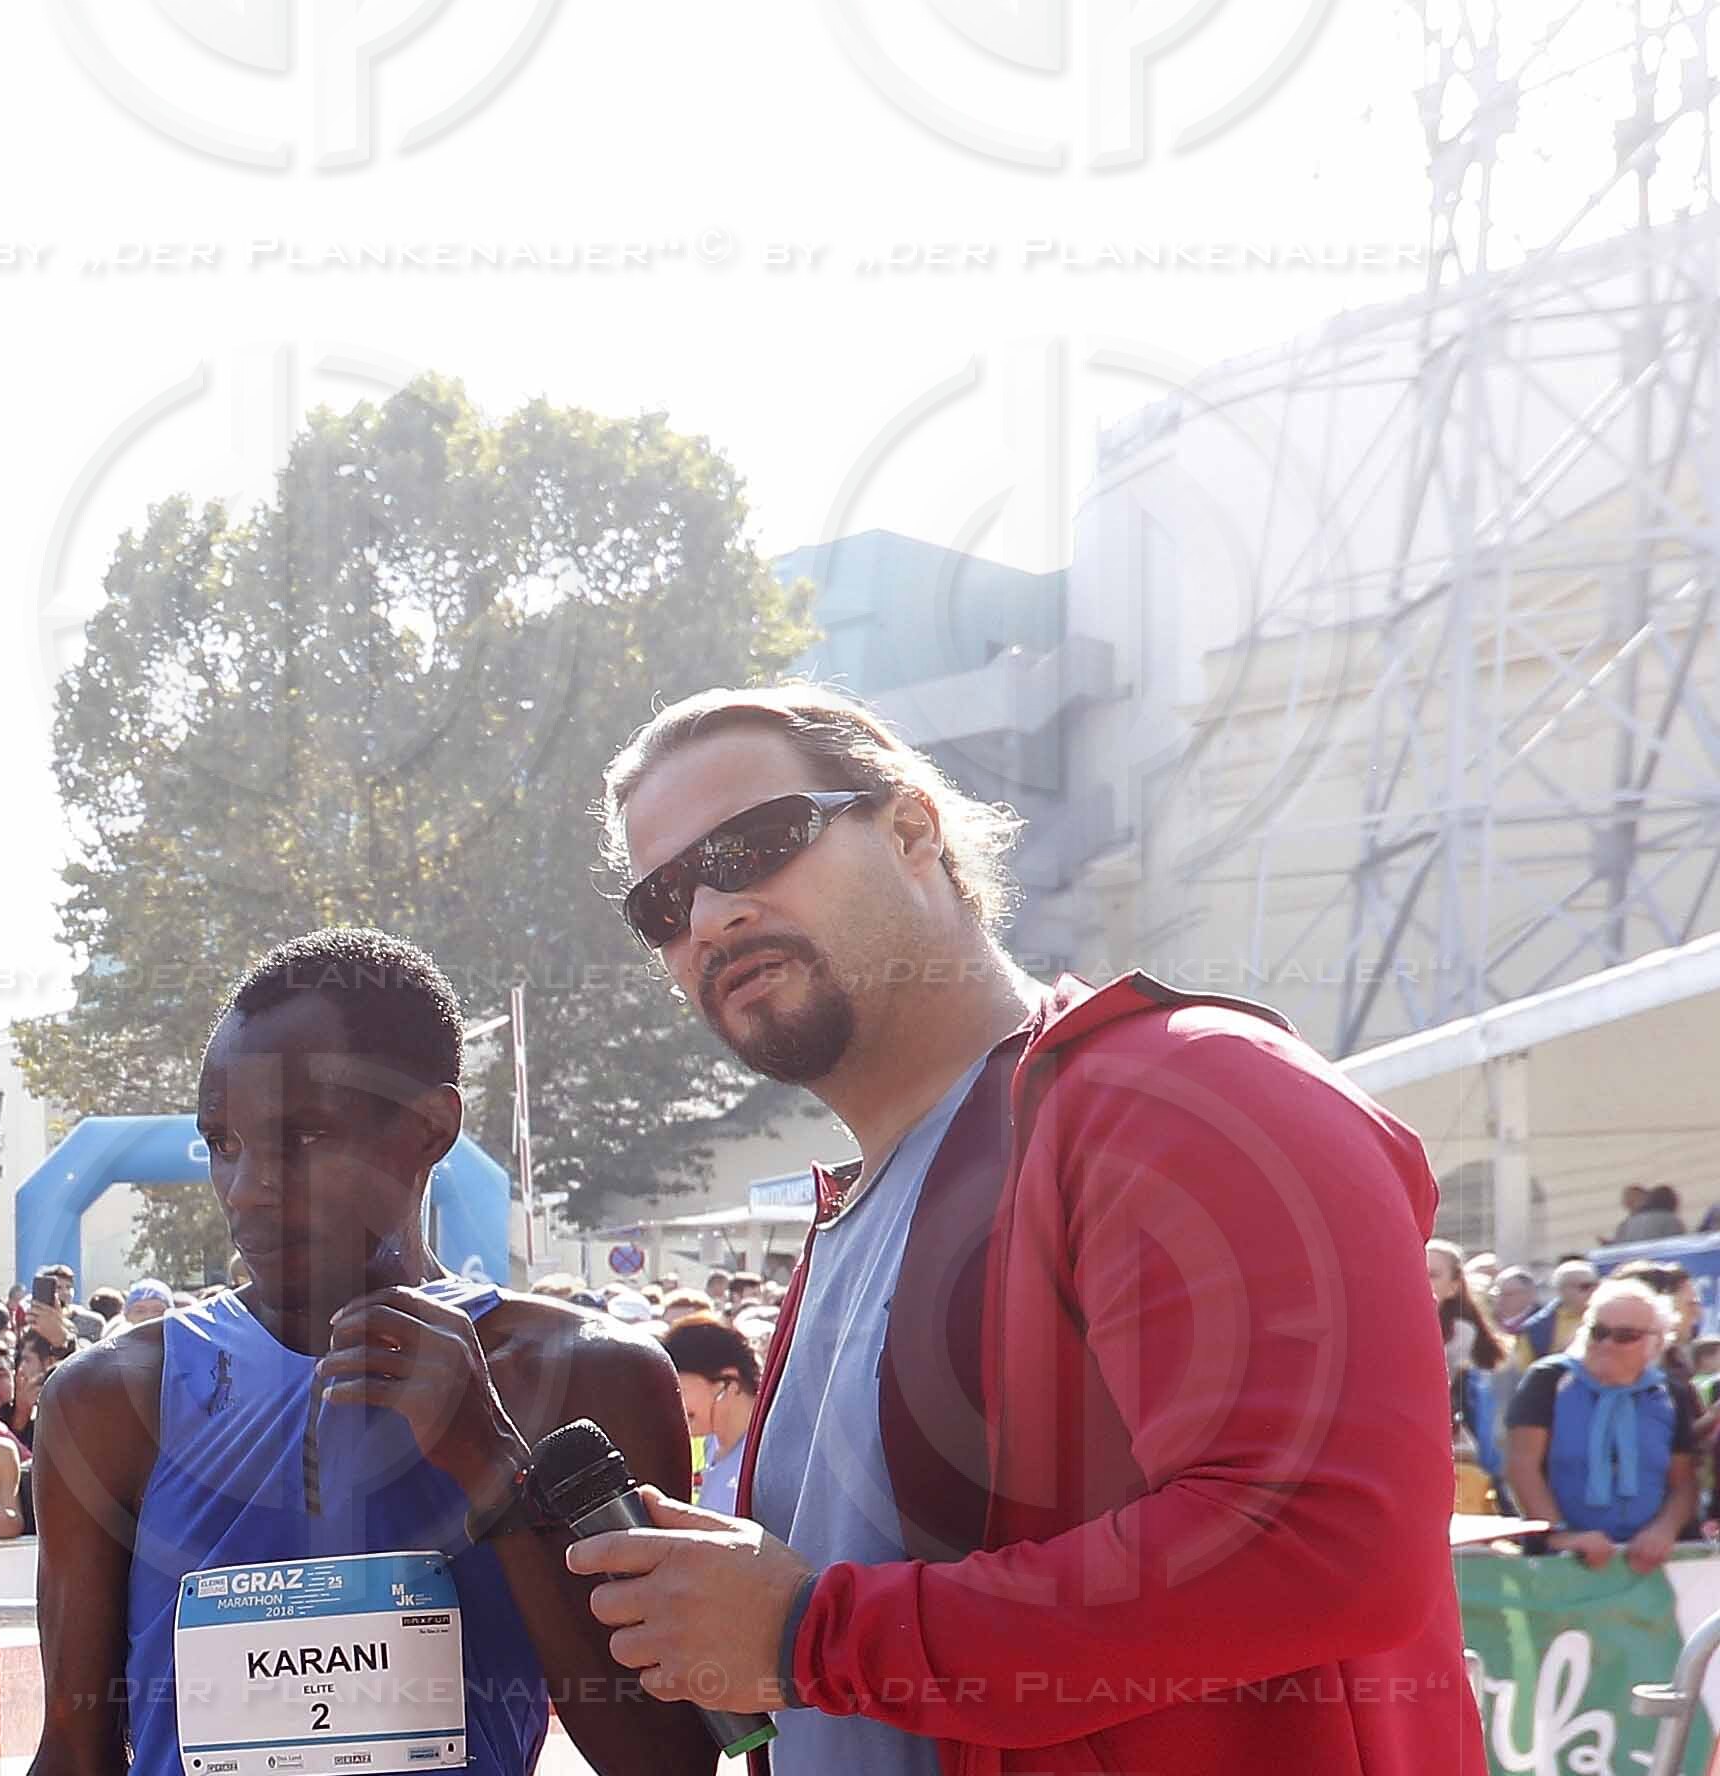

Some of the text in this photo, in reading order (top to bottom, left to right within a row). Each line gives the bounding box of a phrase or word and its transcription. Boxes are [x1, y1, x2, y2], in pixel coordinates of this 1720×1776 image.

[231, 1568, 304, 1594] GRAZ
[327, 1575, 343, 1587] 25
[217, 1594, 283, 1610] MARATHON
[266, 1606, 295, 1618] 2018
[246, 1642, 390, 1680] KARANI
[303, 1684, 335, 1695] ELITE
[310, 1703, 331, 1731] 2
